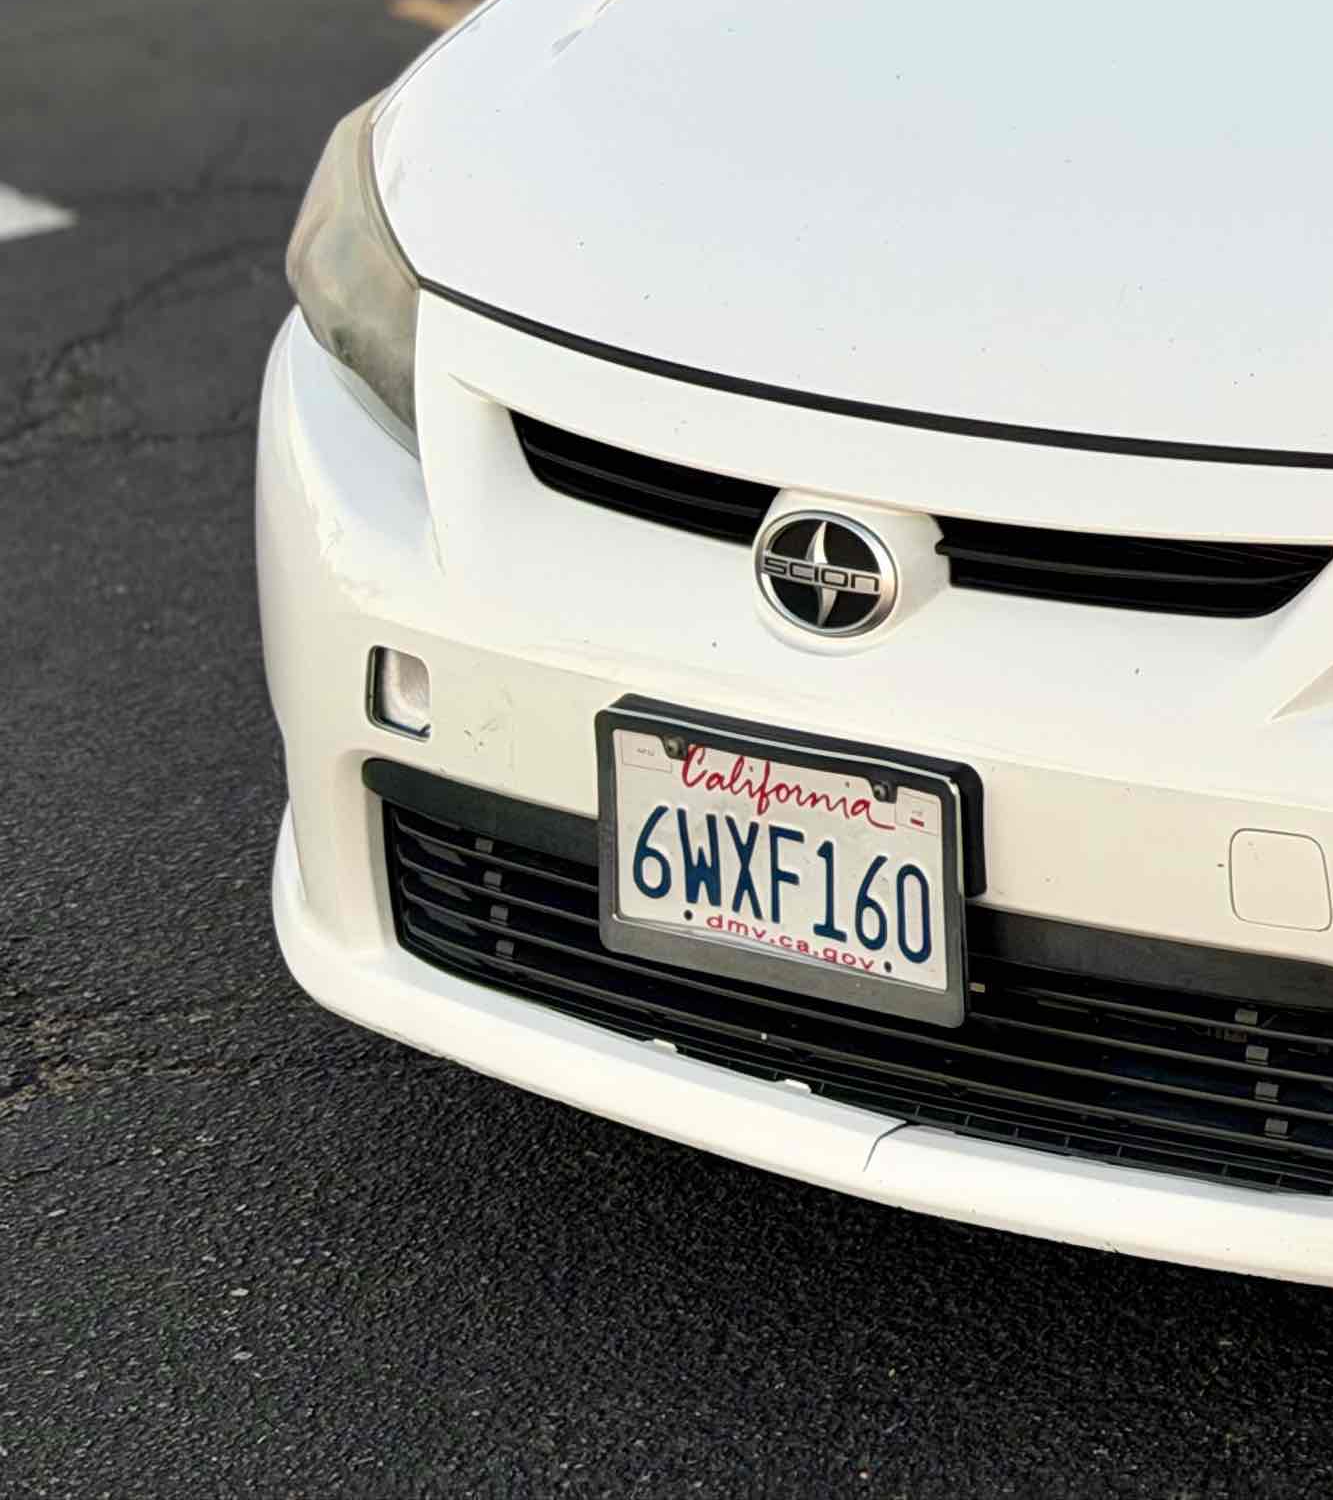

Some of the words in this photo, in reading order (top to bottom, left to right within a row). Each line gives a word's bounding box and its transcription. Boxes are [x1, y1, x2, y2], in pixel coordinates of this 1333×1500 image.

[682, 743, 896, 830] California
[632, 804, 933, 964] 6WXF160
[706, 913, 876, 972] dmv.ca.gov
